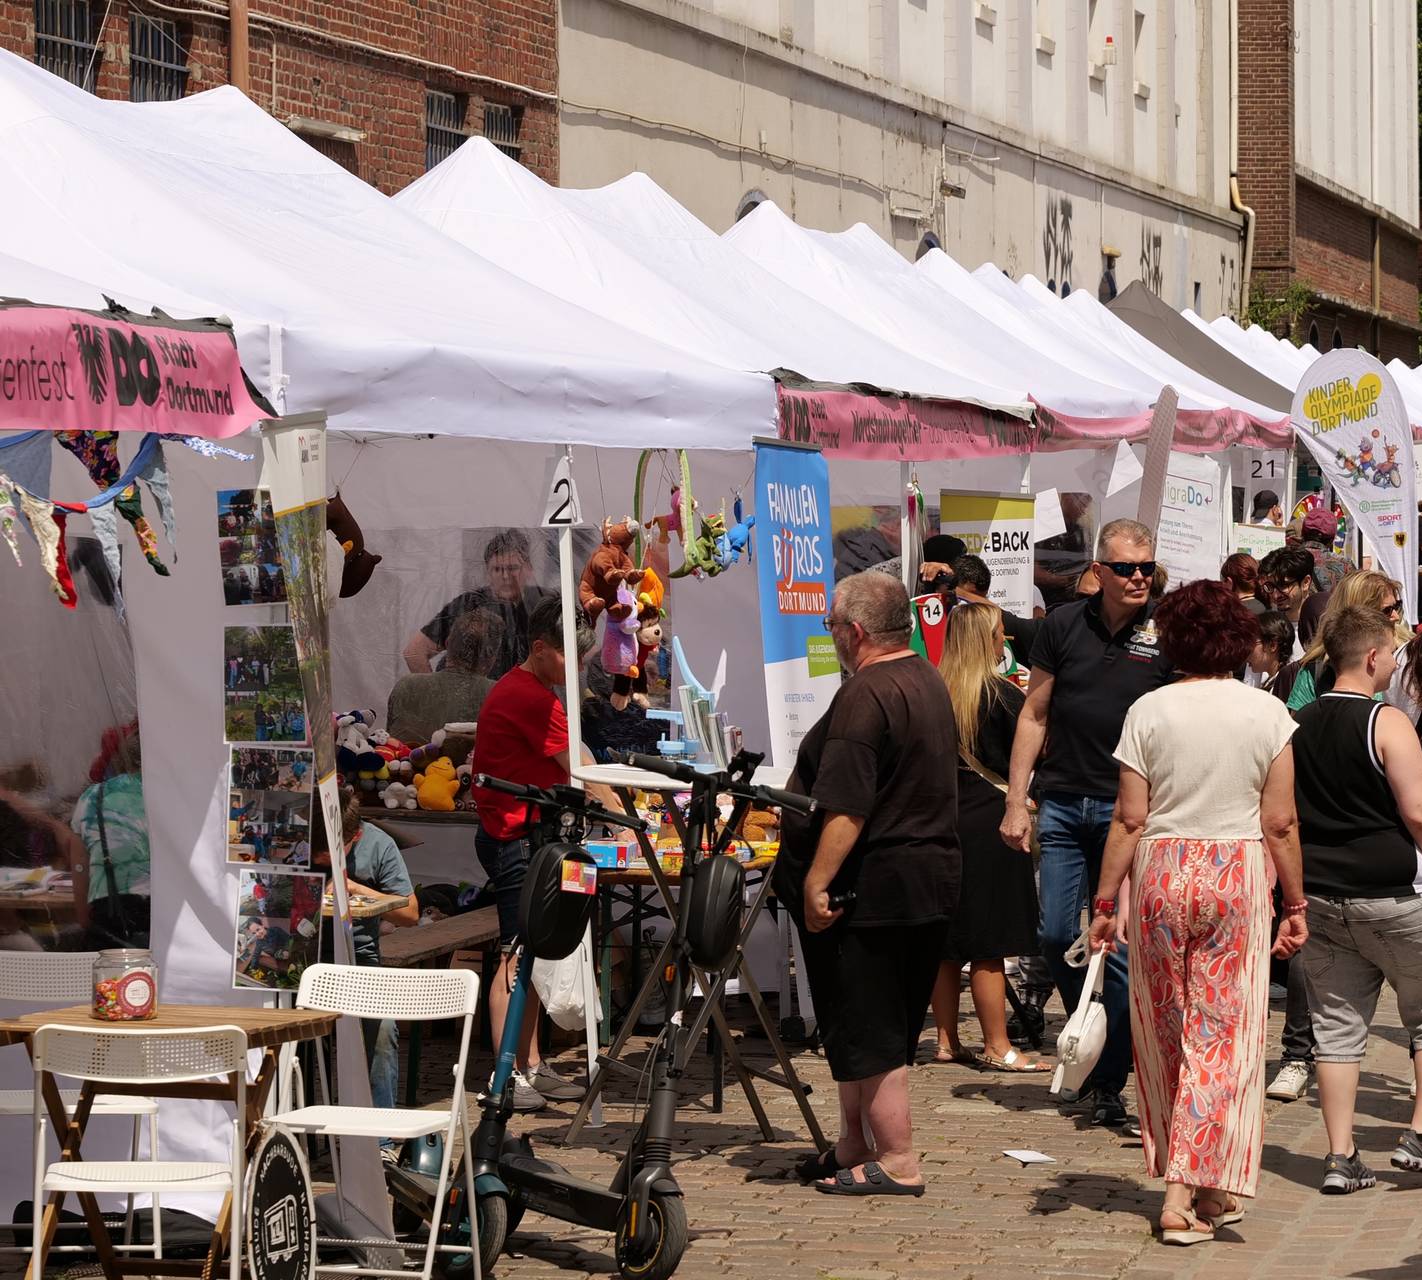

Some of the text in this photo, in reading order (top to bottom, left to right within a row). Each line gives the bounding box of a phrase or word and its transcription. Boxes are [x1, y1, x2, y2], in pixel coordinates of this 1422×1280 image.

[106, 327, 162, 406] DO
[155, 335, 198, 370] Stadt
[1, 346, 75, 401] enfest
[1308, 376, 1351, 403] KINDER
[167, 377, 235, 416] Dortmund
[1310, 385, 1378, 419] OLYMPIADE
[1311, 402, 1378, 436] DORTMUND
[1251, 459, 1275, 478] 21
[548, 478, 572, 524] 2
[767, 482, 819, 528] FAMILIEN
[1377, 514, 1402, 522] SPORT
[772, 527, 823, 589] BÜROS
[991, 531, 1030, 552] BACK
[778, 591, 826, 612] DORTMUND
[925, 604, 941, 619] 14
[258, 1143, 299, 1183] NACHBARBUDE
[299, 1190, 311, 1280] NACHBAR
